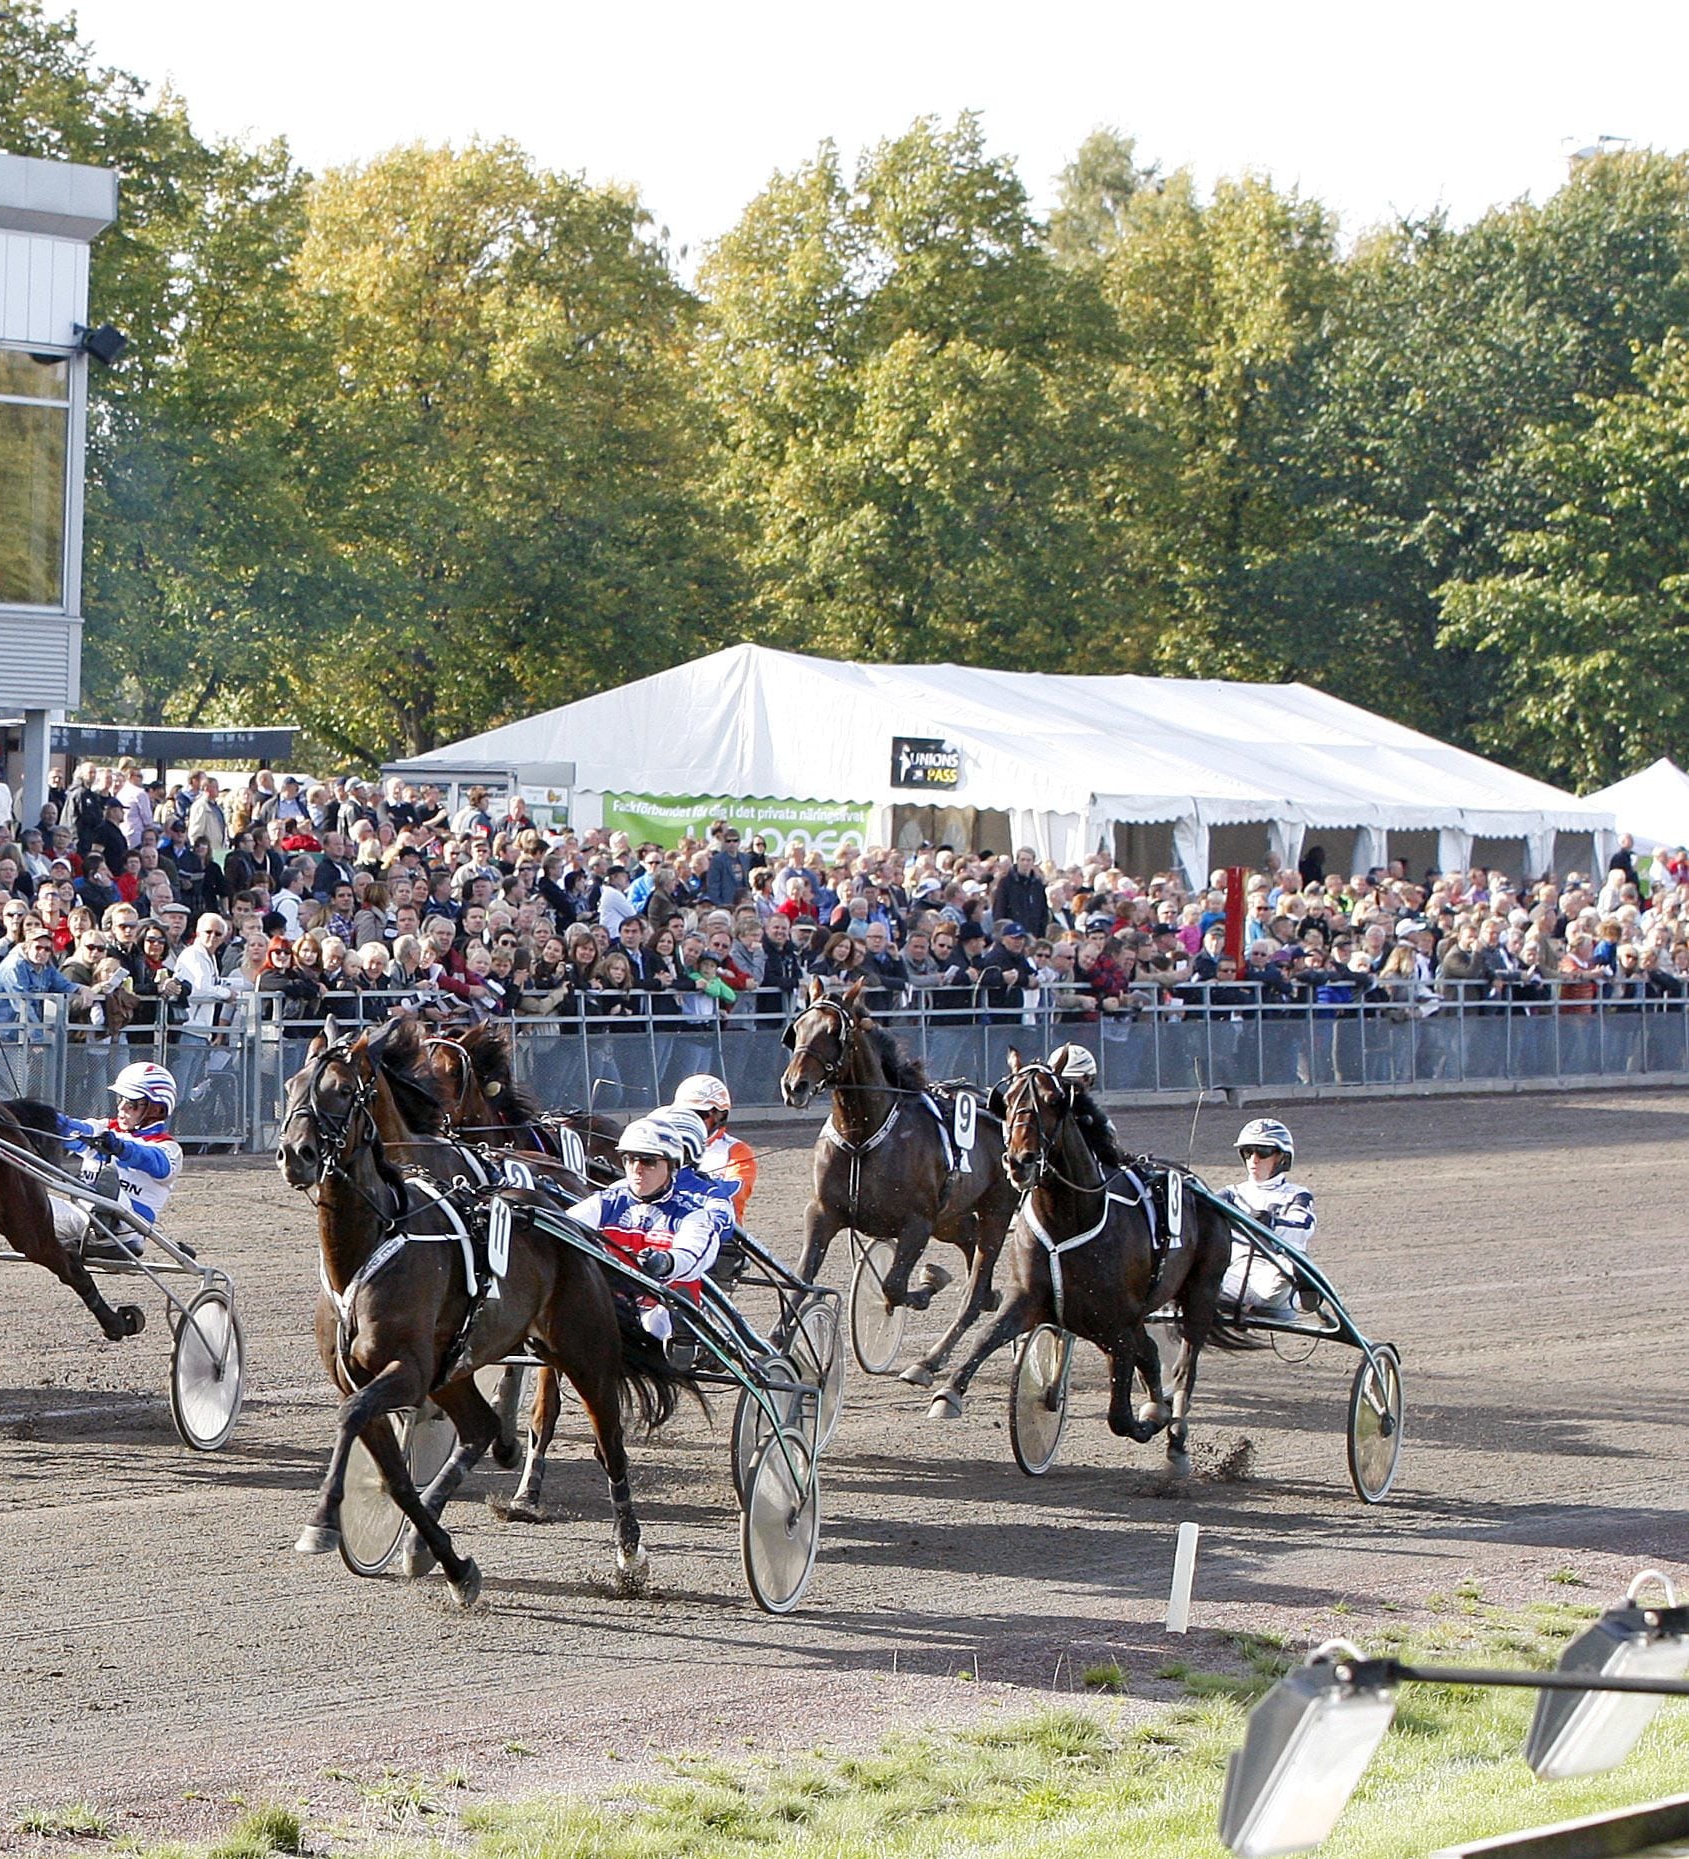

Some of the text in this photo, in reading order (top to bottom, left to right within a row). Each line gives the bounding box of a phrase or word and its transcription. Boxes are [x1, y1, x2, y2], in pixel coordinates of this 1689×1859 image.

[910, 752, 958, 767] UNIONS
[927, 768, 958, 783] PASS
[613, 799, 691, 817] Fackförbundet
[692, 805, 708, 818] för
[709, 803, 727, 820] dig
[736, 805, 754, 818] det
[758, 806, 796, 821] privata
[799, 806, 864, 824] näringslivet
[958, 1094, 972, 1133] 9
[563, 1130, 584, 1174] 10
[1171, 1173, 1179, 1218] 3
[495, 1201, 508, 1256] 11
